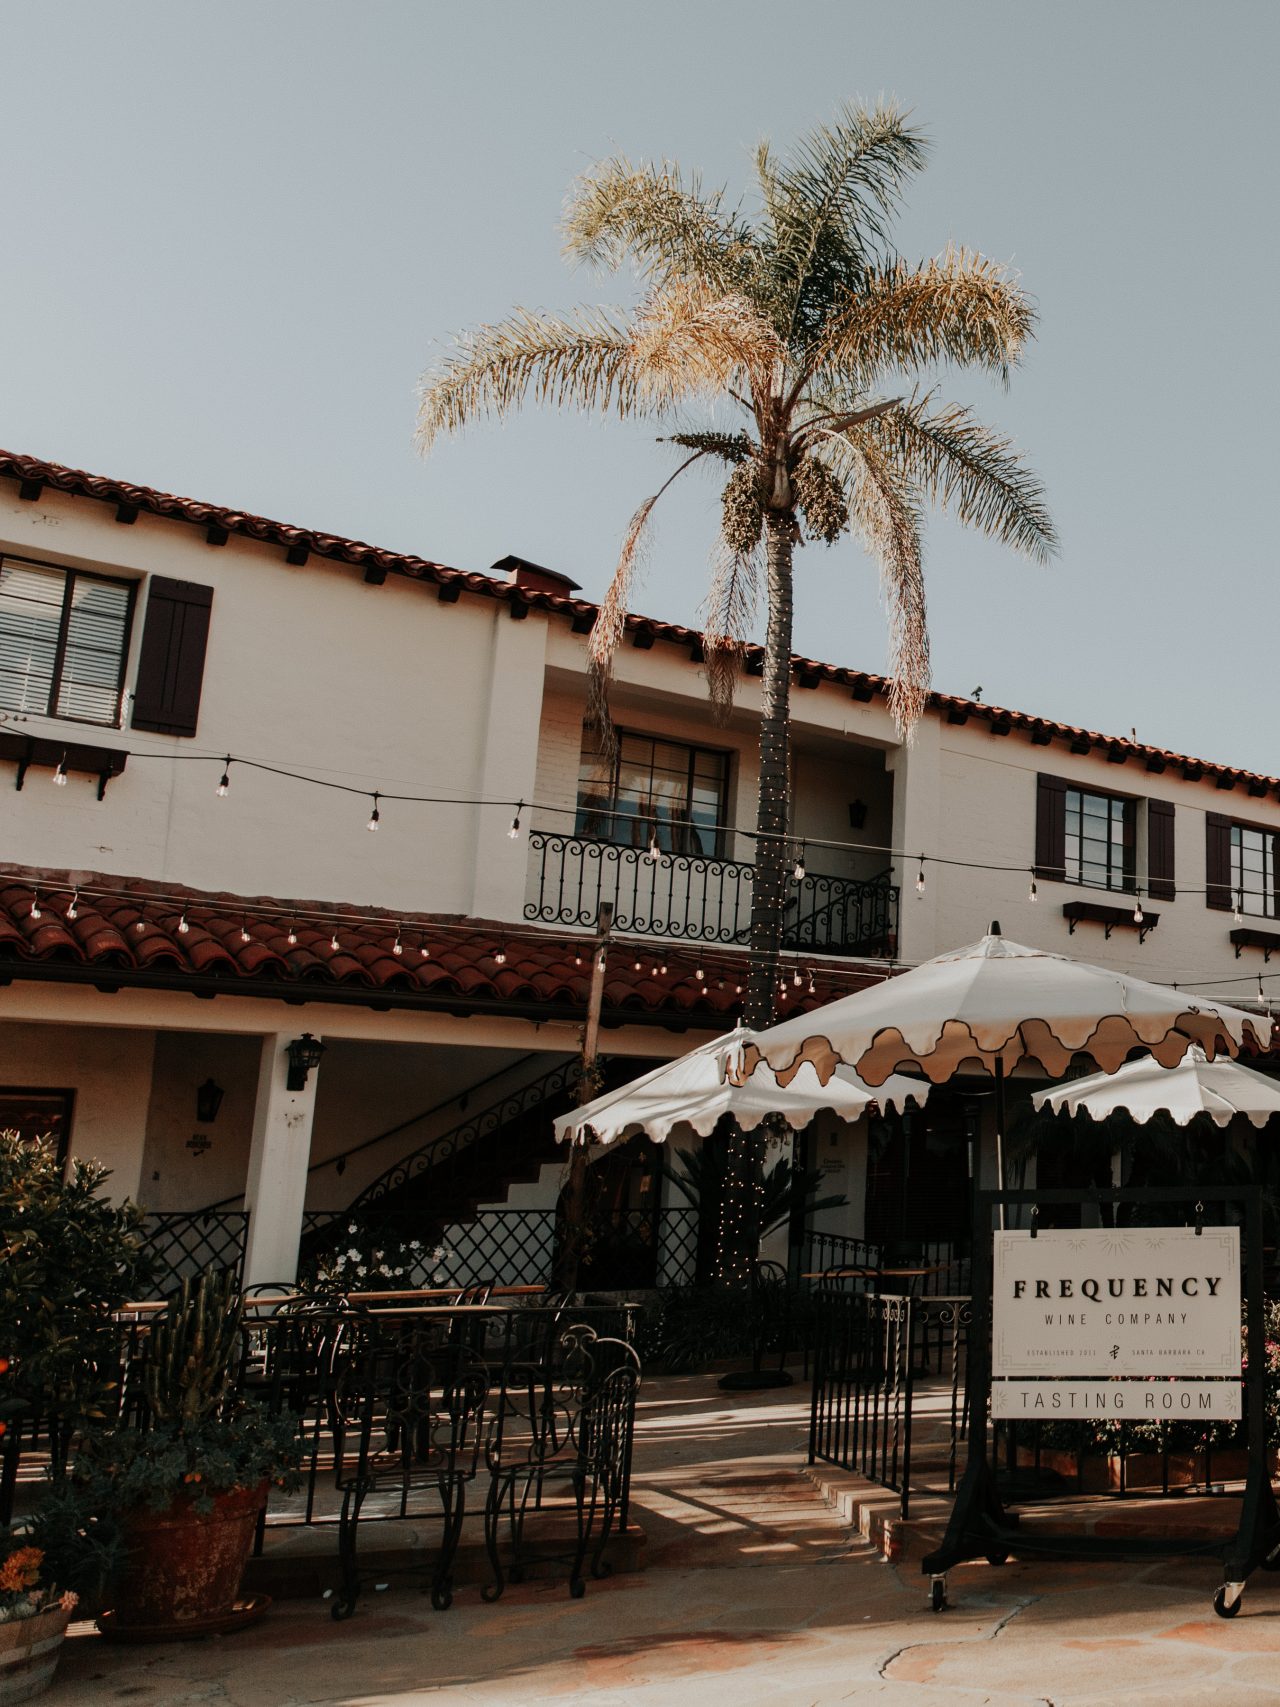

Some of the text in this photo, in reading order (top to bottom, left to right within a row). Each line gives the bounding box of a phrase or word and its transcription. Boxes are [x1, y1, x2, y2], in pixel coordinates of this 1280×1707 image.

[1013, 1277, 1222, 1303] FREQUENCY
[1045, 1312, 1188, 1325] WINE COMPANY
[1020, 1392, 1212, 1409] TASTING ROOM
